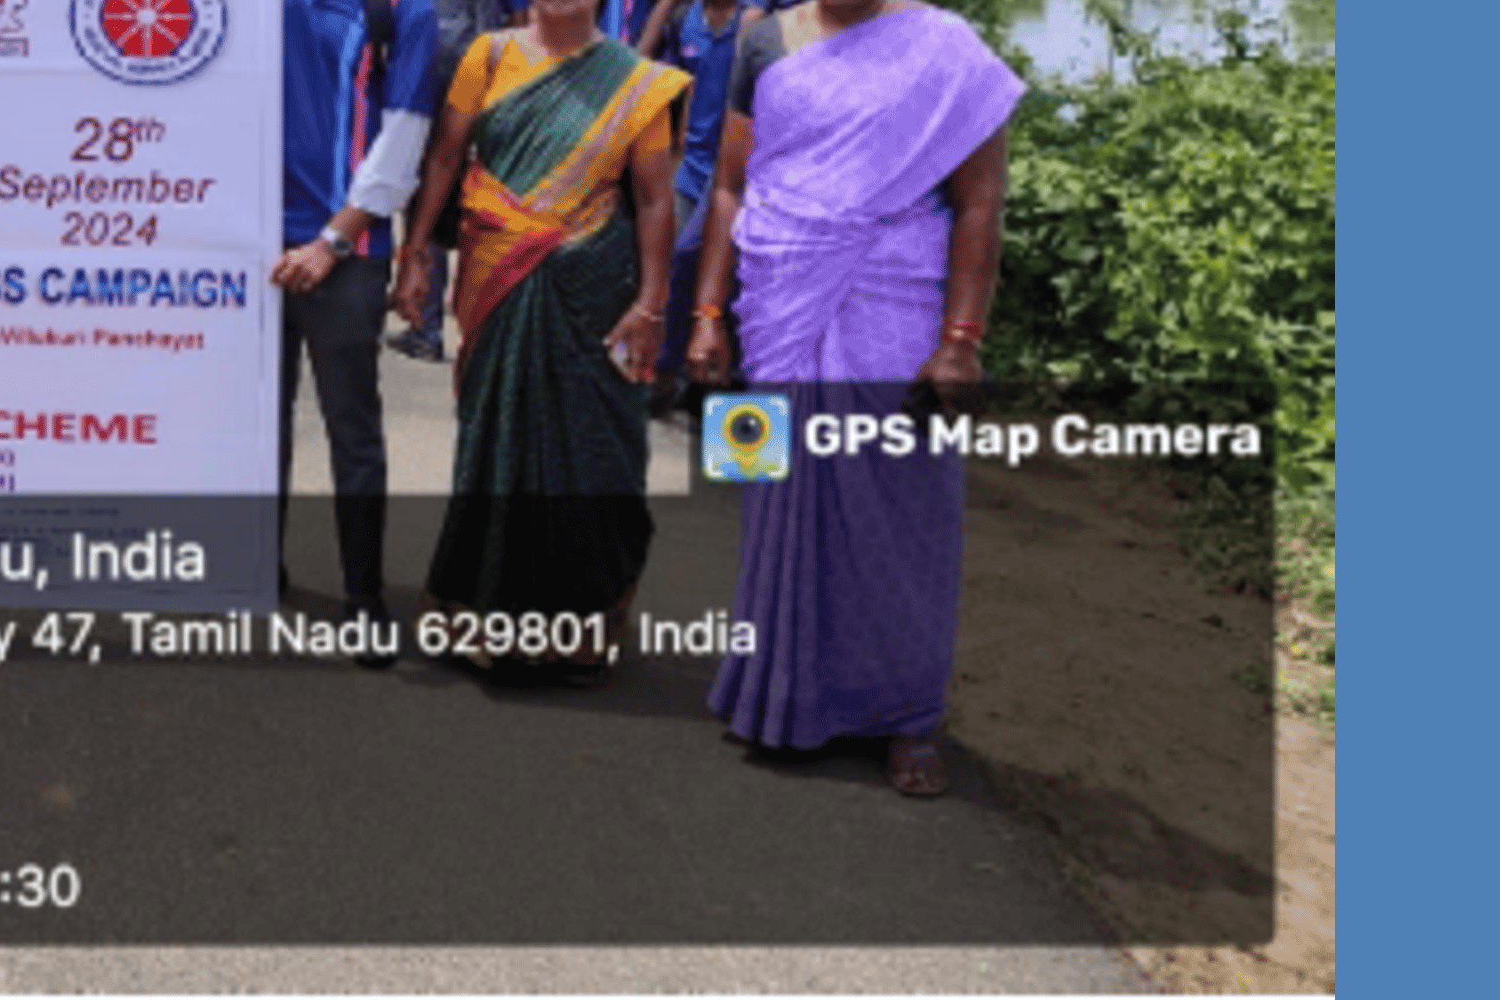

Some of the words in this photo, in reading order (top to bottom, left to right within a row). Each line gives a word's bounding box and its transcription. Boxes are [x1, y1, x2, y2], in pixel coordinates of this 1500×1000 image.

[70, 116, 167, 164] 28th
[60, 211, 159, 246] 2024
[40, 266, 247, 309] CAMPAIGN
